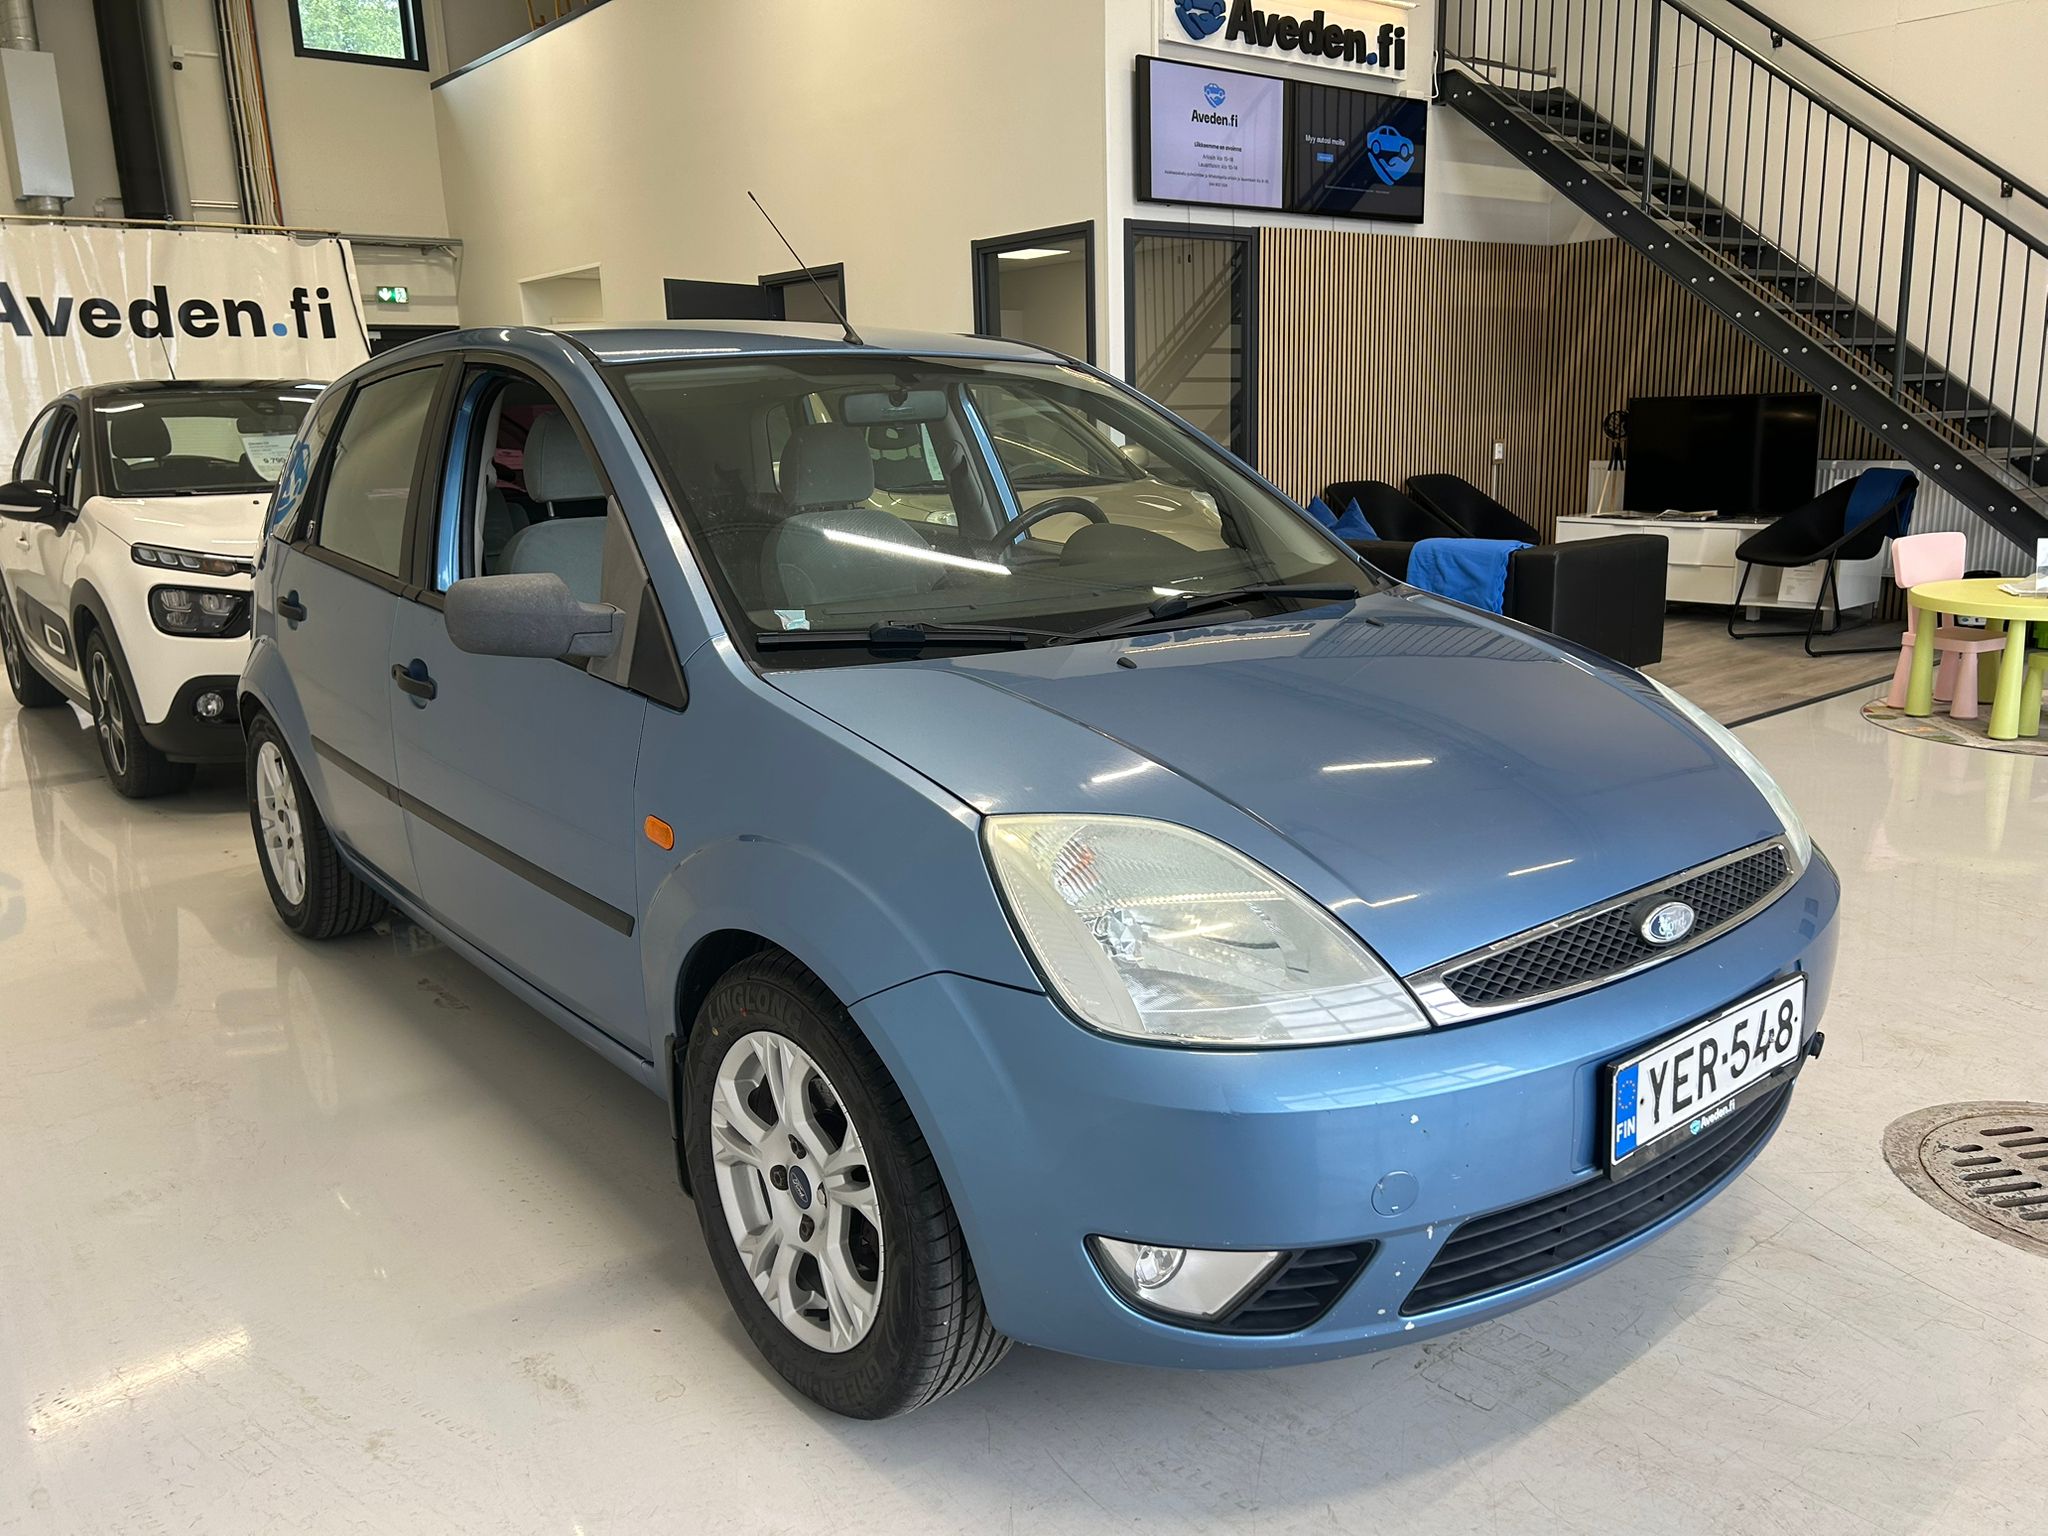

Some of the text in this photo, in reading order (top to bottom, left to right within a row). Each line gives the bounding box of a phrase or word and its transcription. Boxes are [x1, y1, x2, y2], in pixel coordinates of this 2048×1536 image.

[1225, 0, 1405, 70] Aveden.fi
[1191, 109, 1238, 127] Aveden.fi
[0, 281, 336, 339] Aveden.fi
[1650, 998, 1793, 1124] YER-548
[1616, 1115, 1636, 1143] FIN
[1700, 1098, 1736, 1129] Aveden.fi
